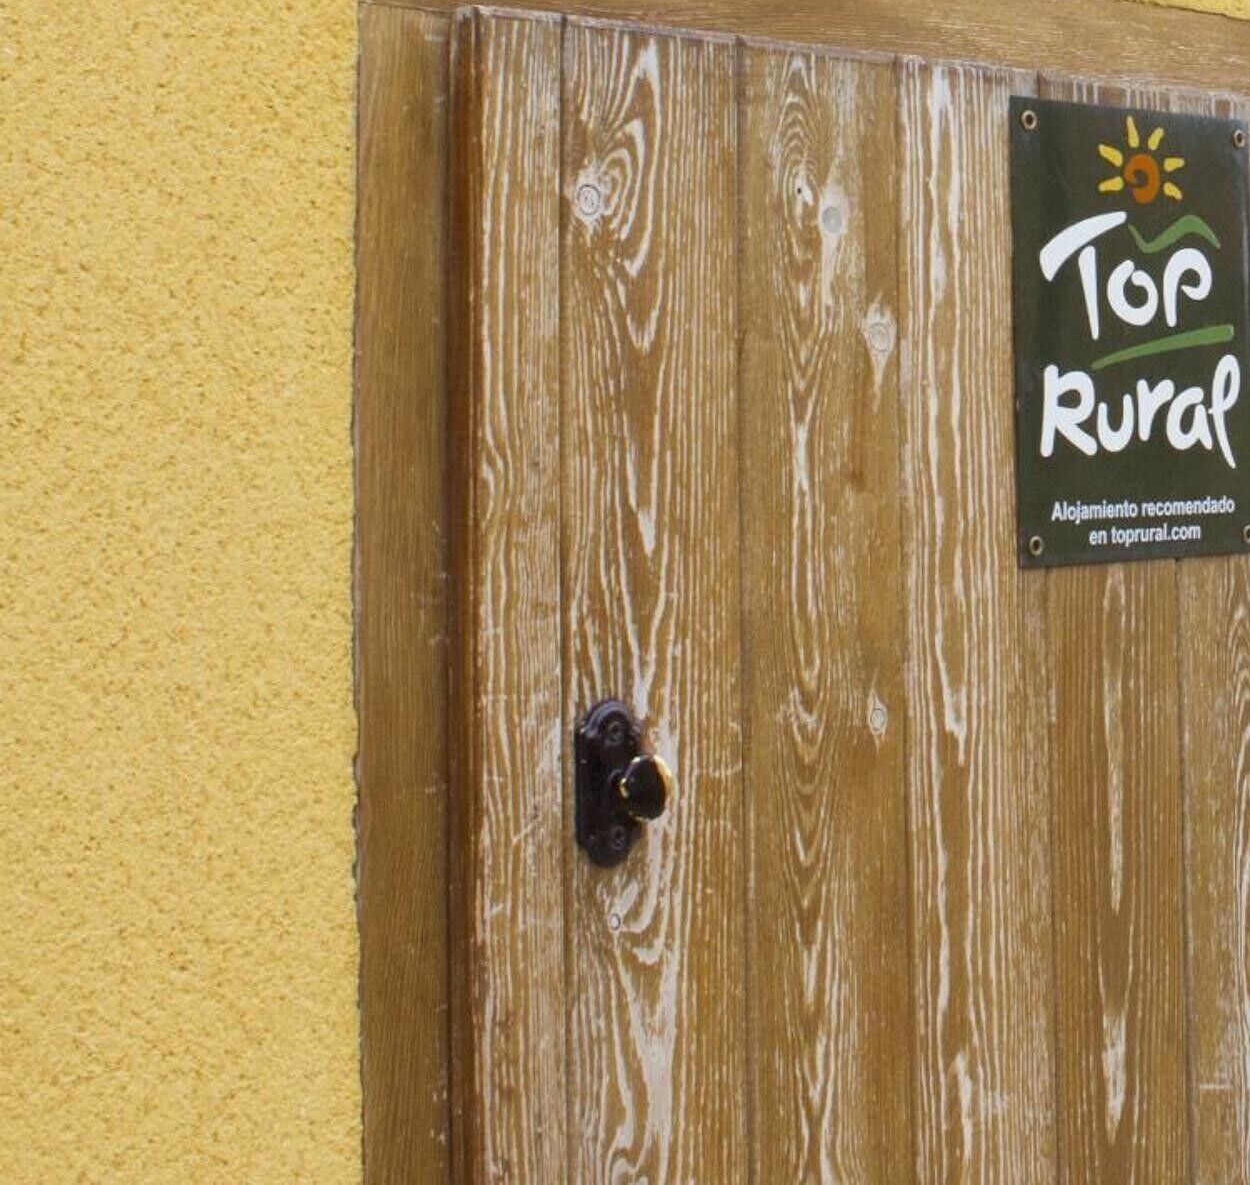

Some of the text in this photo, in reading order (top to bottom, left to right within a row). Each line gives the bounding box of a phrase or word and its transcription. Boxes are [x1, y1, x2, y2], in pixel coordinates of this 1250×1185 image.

[1040, 354, 1241, 469] Rural
[1051, 495, 1236, 524] Alojamiento recomendado
[1089, 523, 1201, 547] en toprural.com
